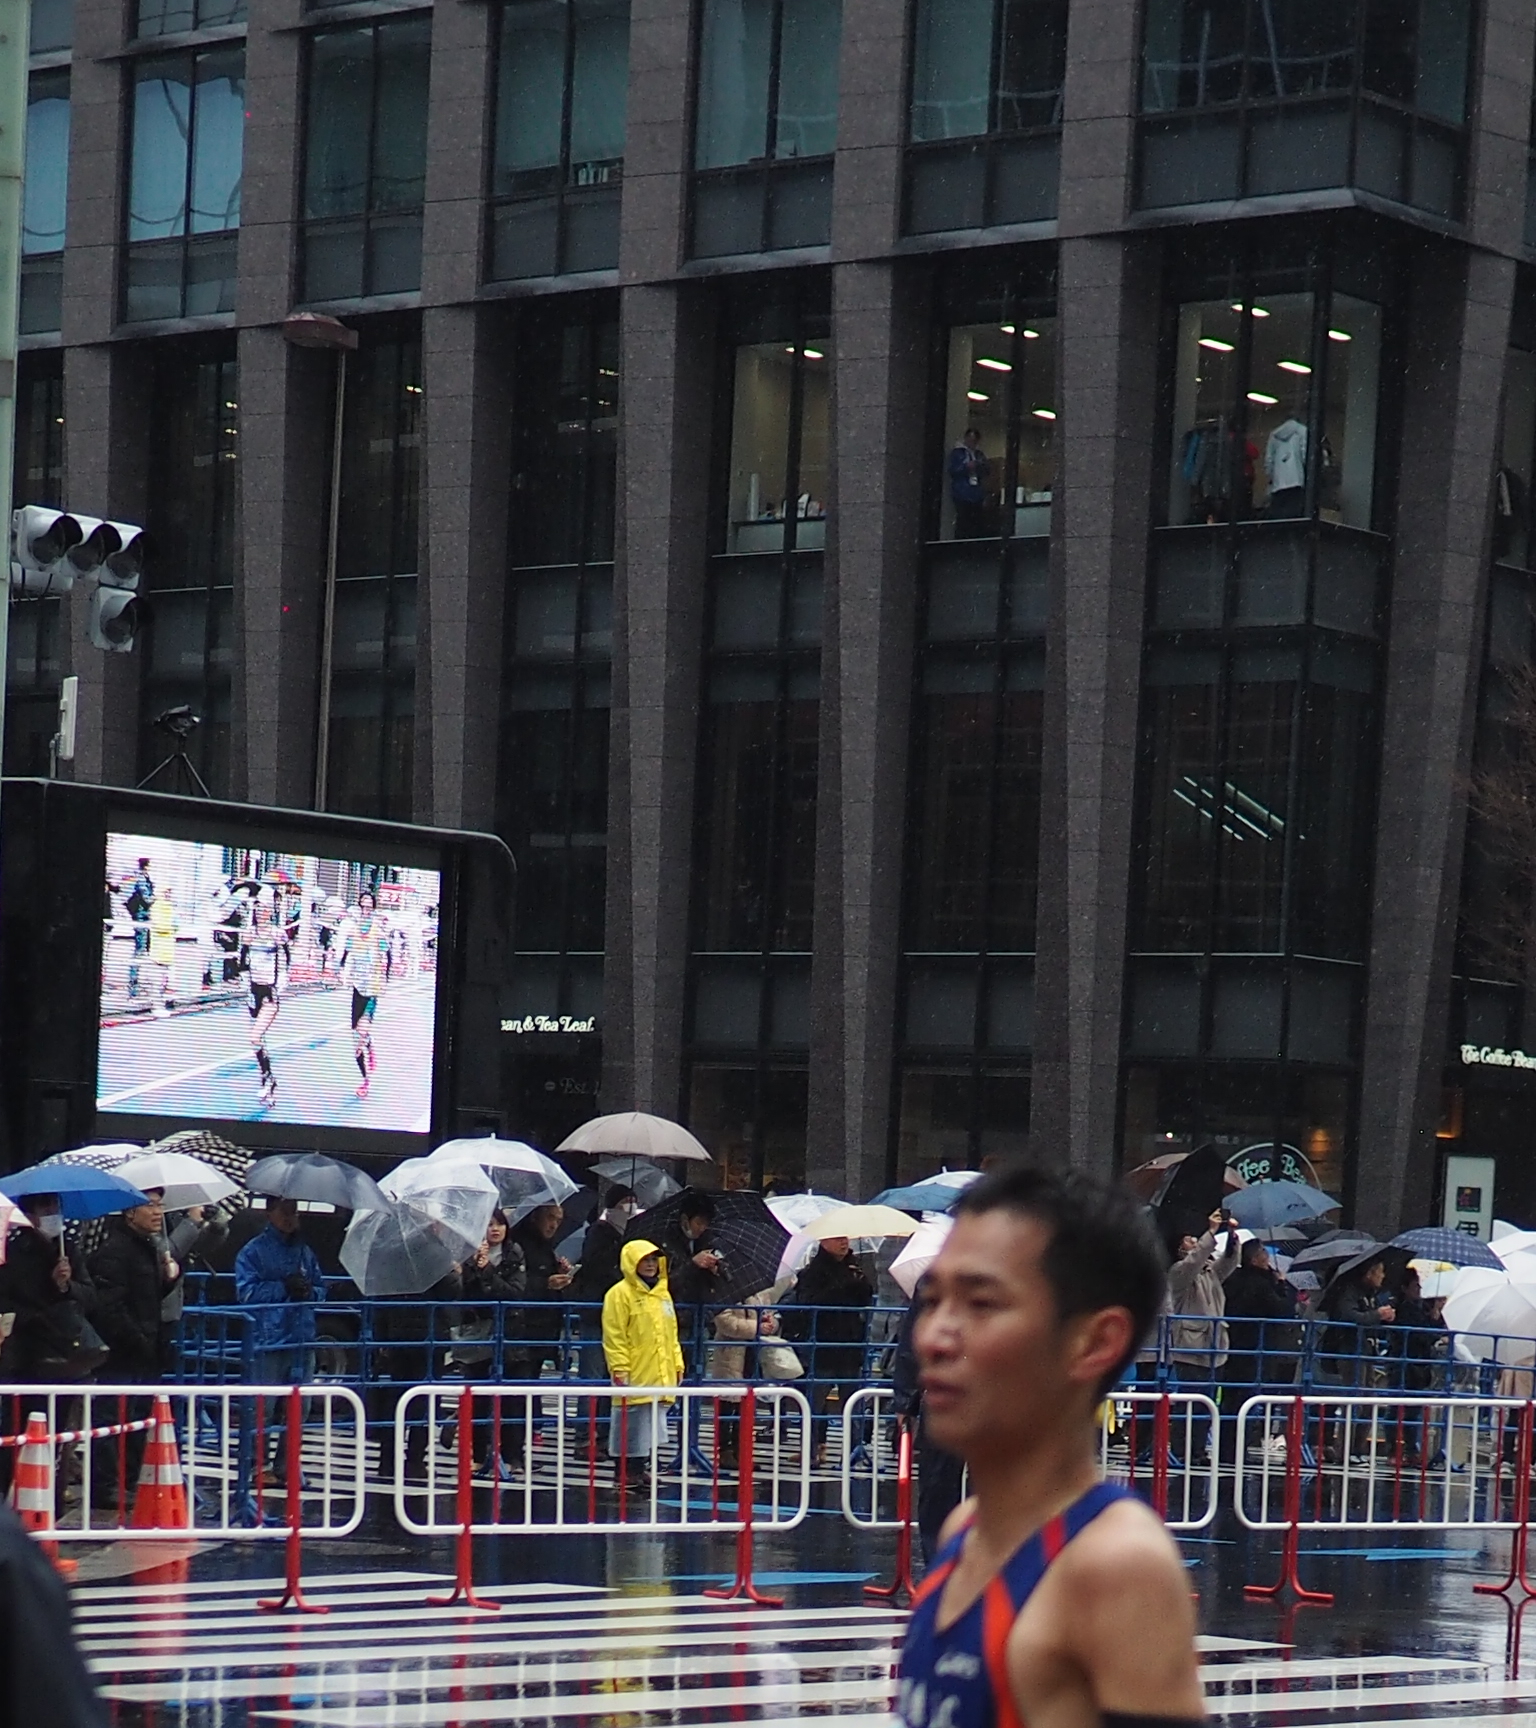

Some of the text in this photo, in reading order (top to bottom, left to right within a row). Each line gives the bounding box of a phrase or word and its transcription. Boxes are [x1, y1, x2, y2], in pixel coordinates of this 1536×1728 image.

[522, 1015, 535, 1032] &
[534, 1015, 560, 1032] Tea
[1460, 1044, 1480, 1065] The
[1480, 1046, 1513, 1067] Coffee
